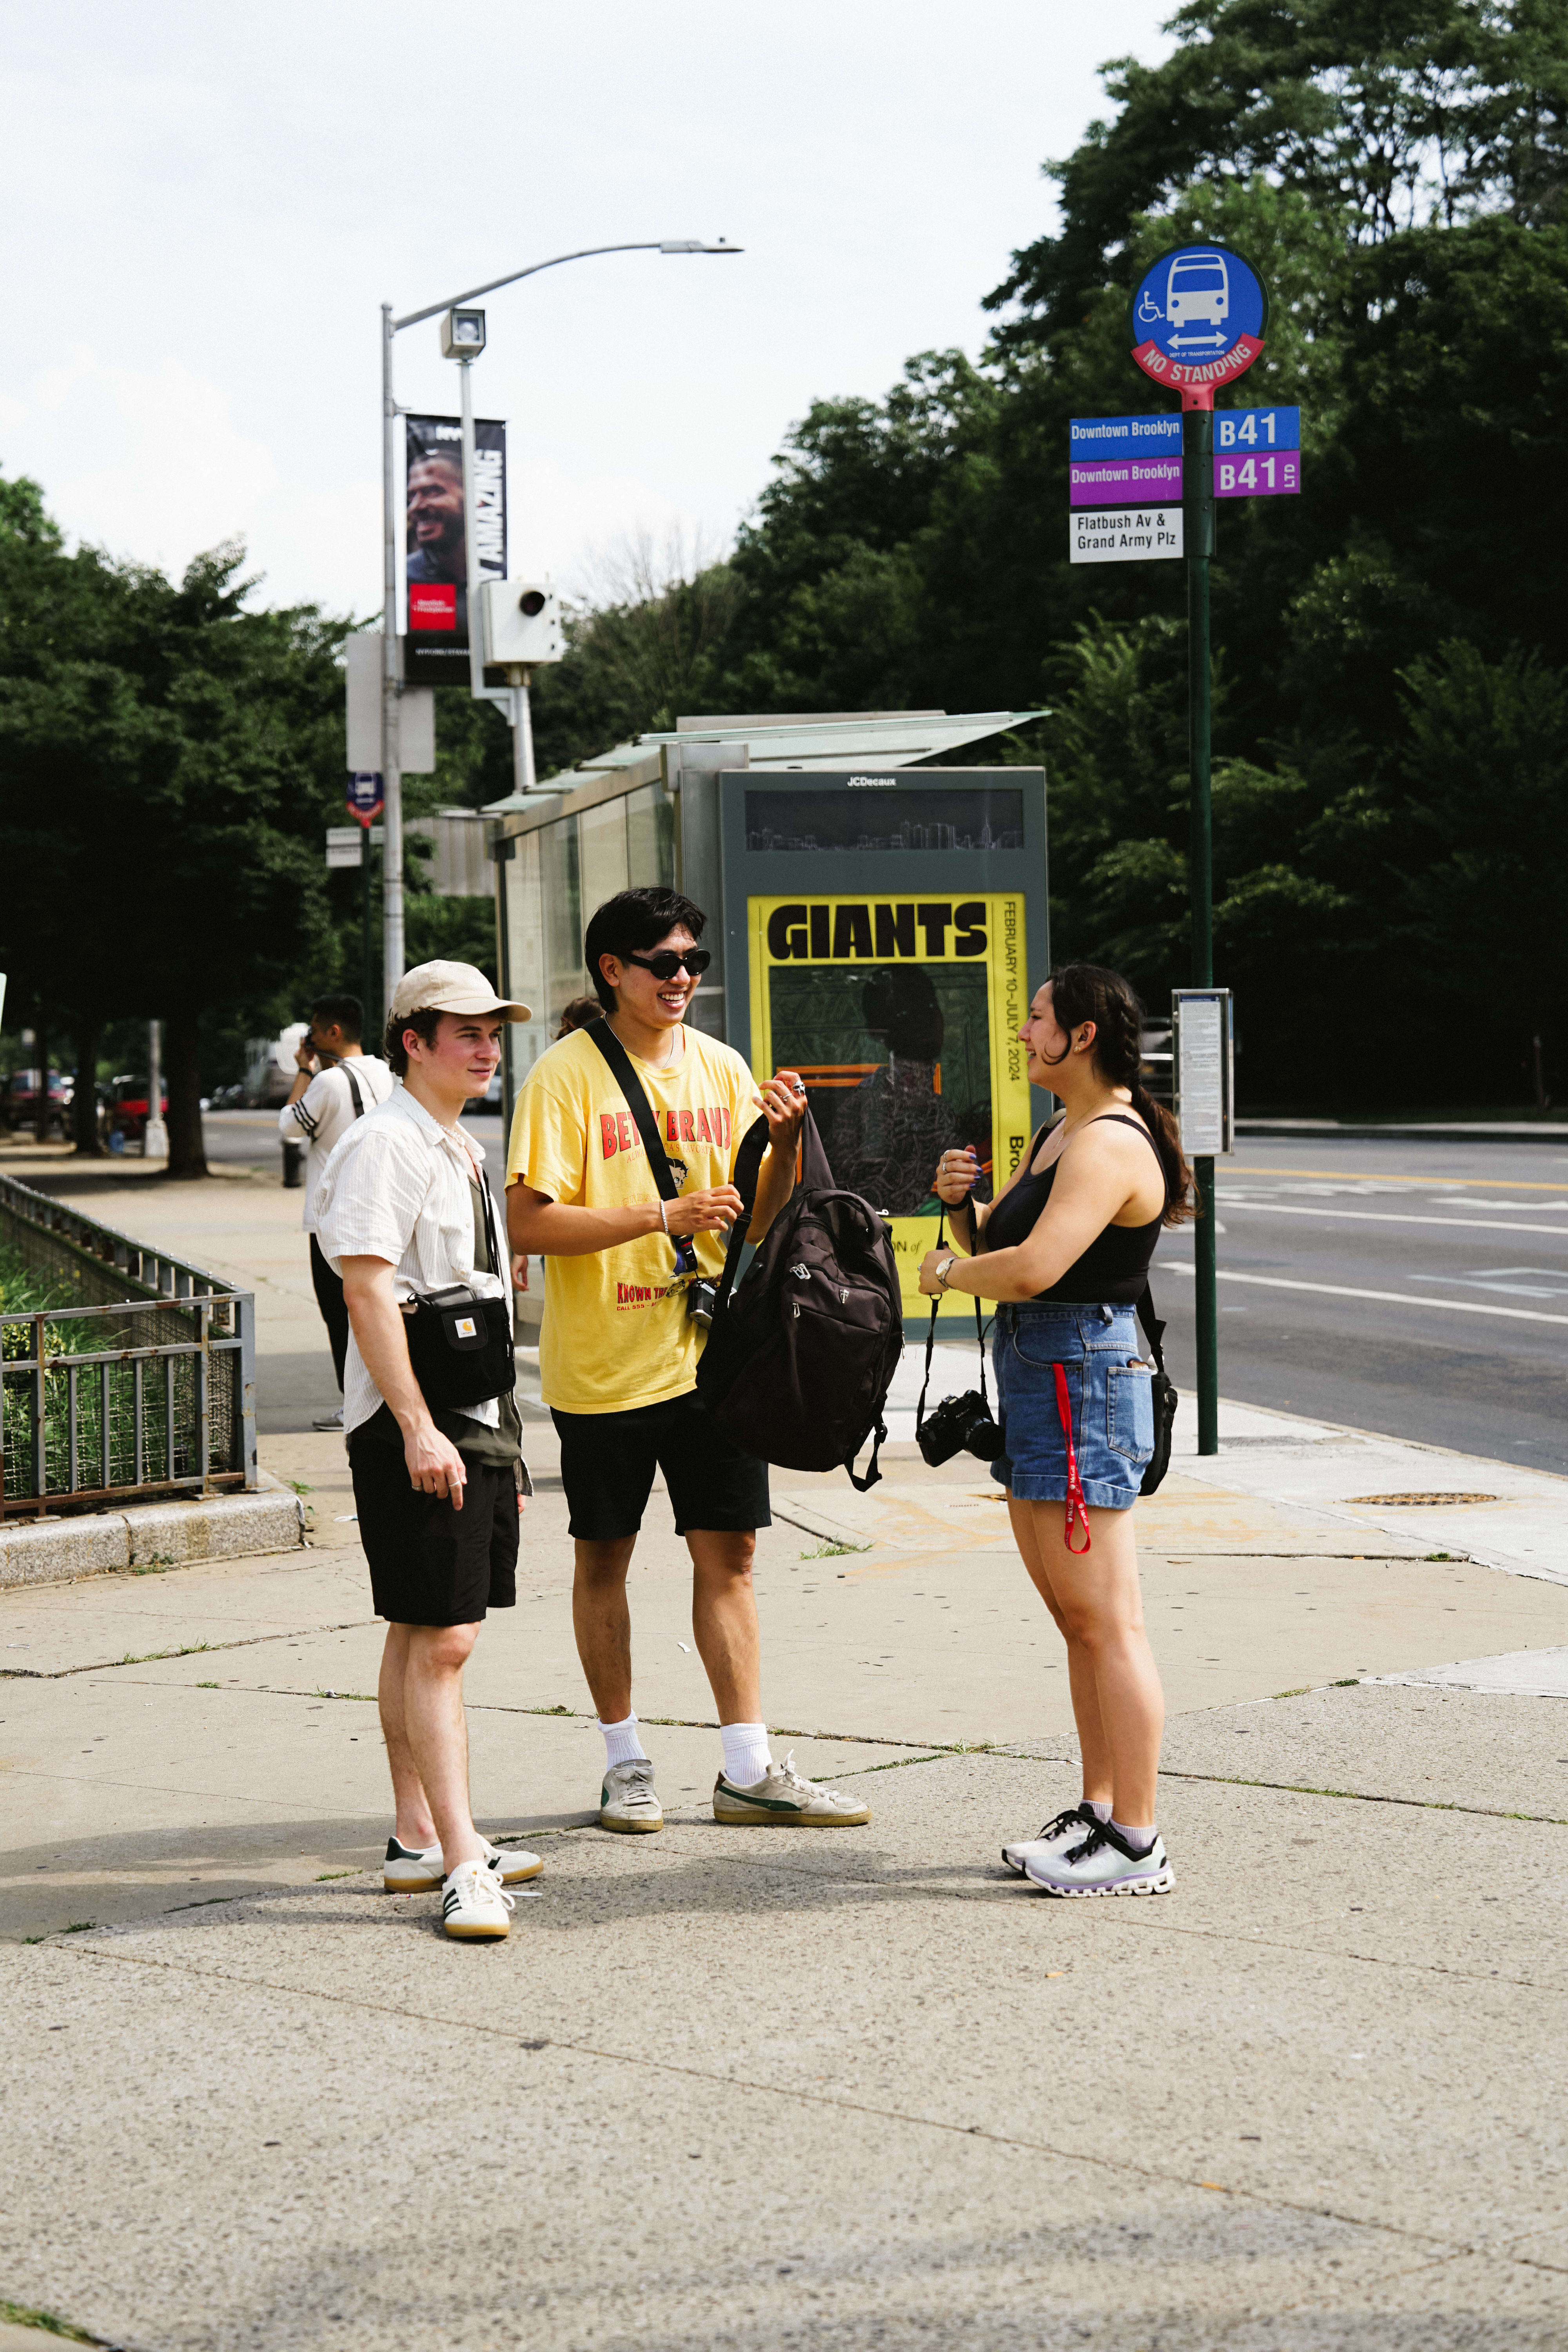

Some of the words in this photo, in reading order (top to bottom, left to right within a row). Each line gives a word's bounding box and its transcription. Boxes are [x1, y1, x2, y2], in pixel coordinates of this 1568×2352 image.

[1143, 348, 1167, 373] NO
[1170, 343, 1252, 383] STANDING
[1071, 425, 1129, 440] Downtown
[1132, 420, 1180, 437] Brooklyn
[1220, 413, 1275, 446] B41
[1071, 468, 1129, 483] Downtown
[1132, 463, 1180, 481] Brooklyn
[1220, 457, 1275, 490] B41
[1284, 464, 1296, 488] LTD
[1078, 515, 1131, 530] Flatbush
[1136, 514, 1151, 527] Av
[1156, 513, 1165, 526] &
[1078, 534, 1114, 549] Grand
[1119, 534, 1152, 549] Army
[1157, 532, 1176, 545] Plz
[847, 776, 897, 787] JCDecaux
[767, 902, 987, 960] GIANTS
[1004, 902, 1016, 975] FEBRUARY
[1009, 1049, 1020, 1081] 2024
[667, 1107, 731, 1150] BRAND
[911, 1240, 922, 1254] of
[617, 1282, 651, 1303] KNOWN
[956, 1408, 970, 1419] Nikon
[1080, 1509, 1089, 1526] McGill
